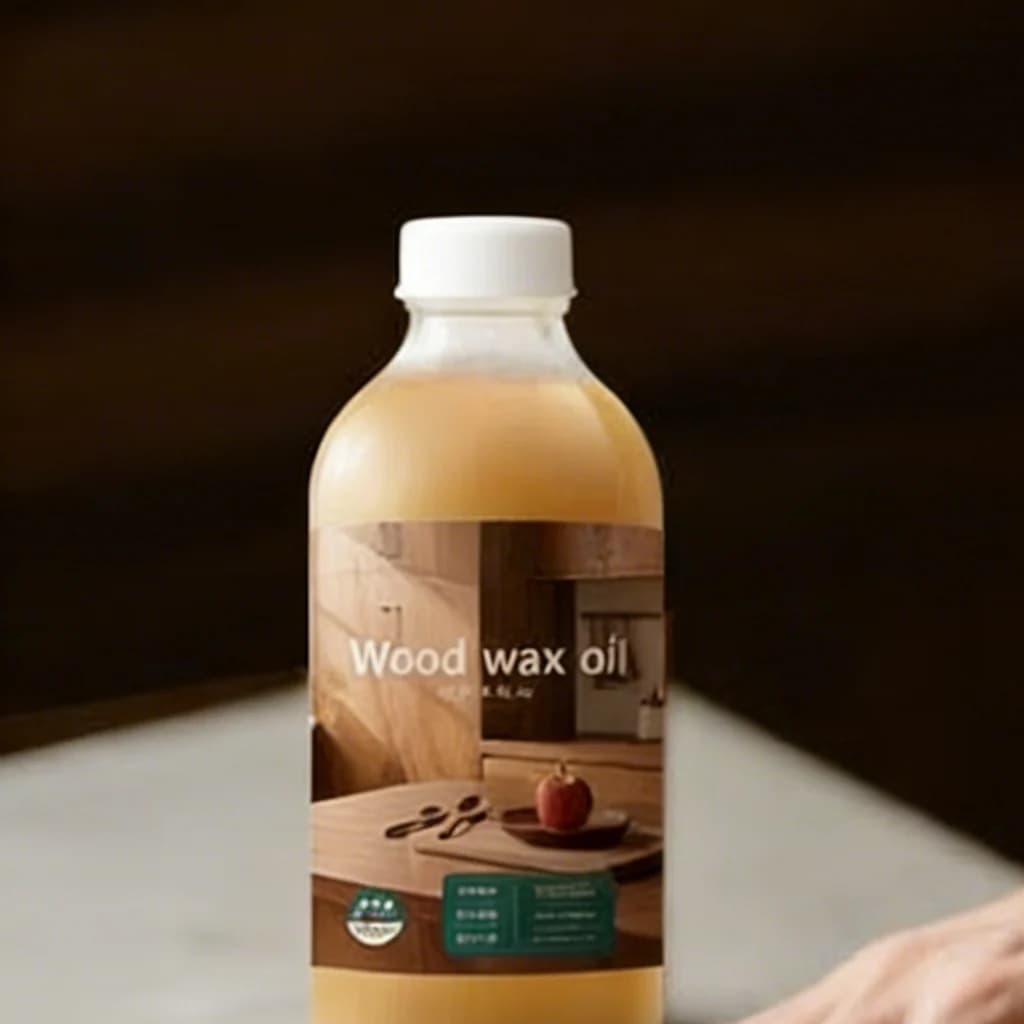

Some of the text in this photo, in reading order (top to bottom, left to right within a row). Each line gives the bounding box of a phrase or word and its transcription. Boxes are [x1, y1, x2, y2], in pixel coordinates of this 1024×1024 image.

[349, 633, 627, 677] Wood wax oil
